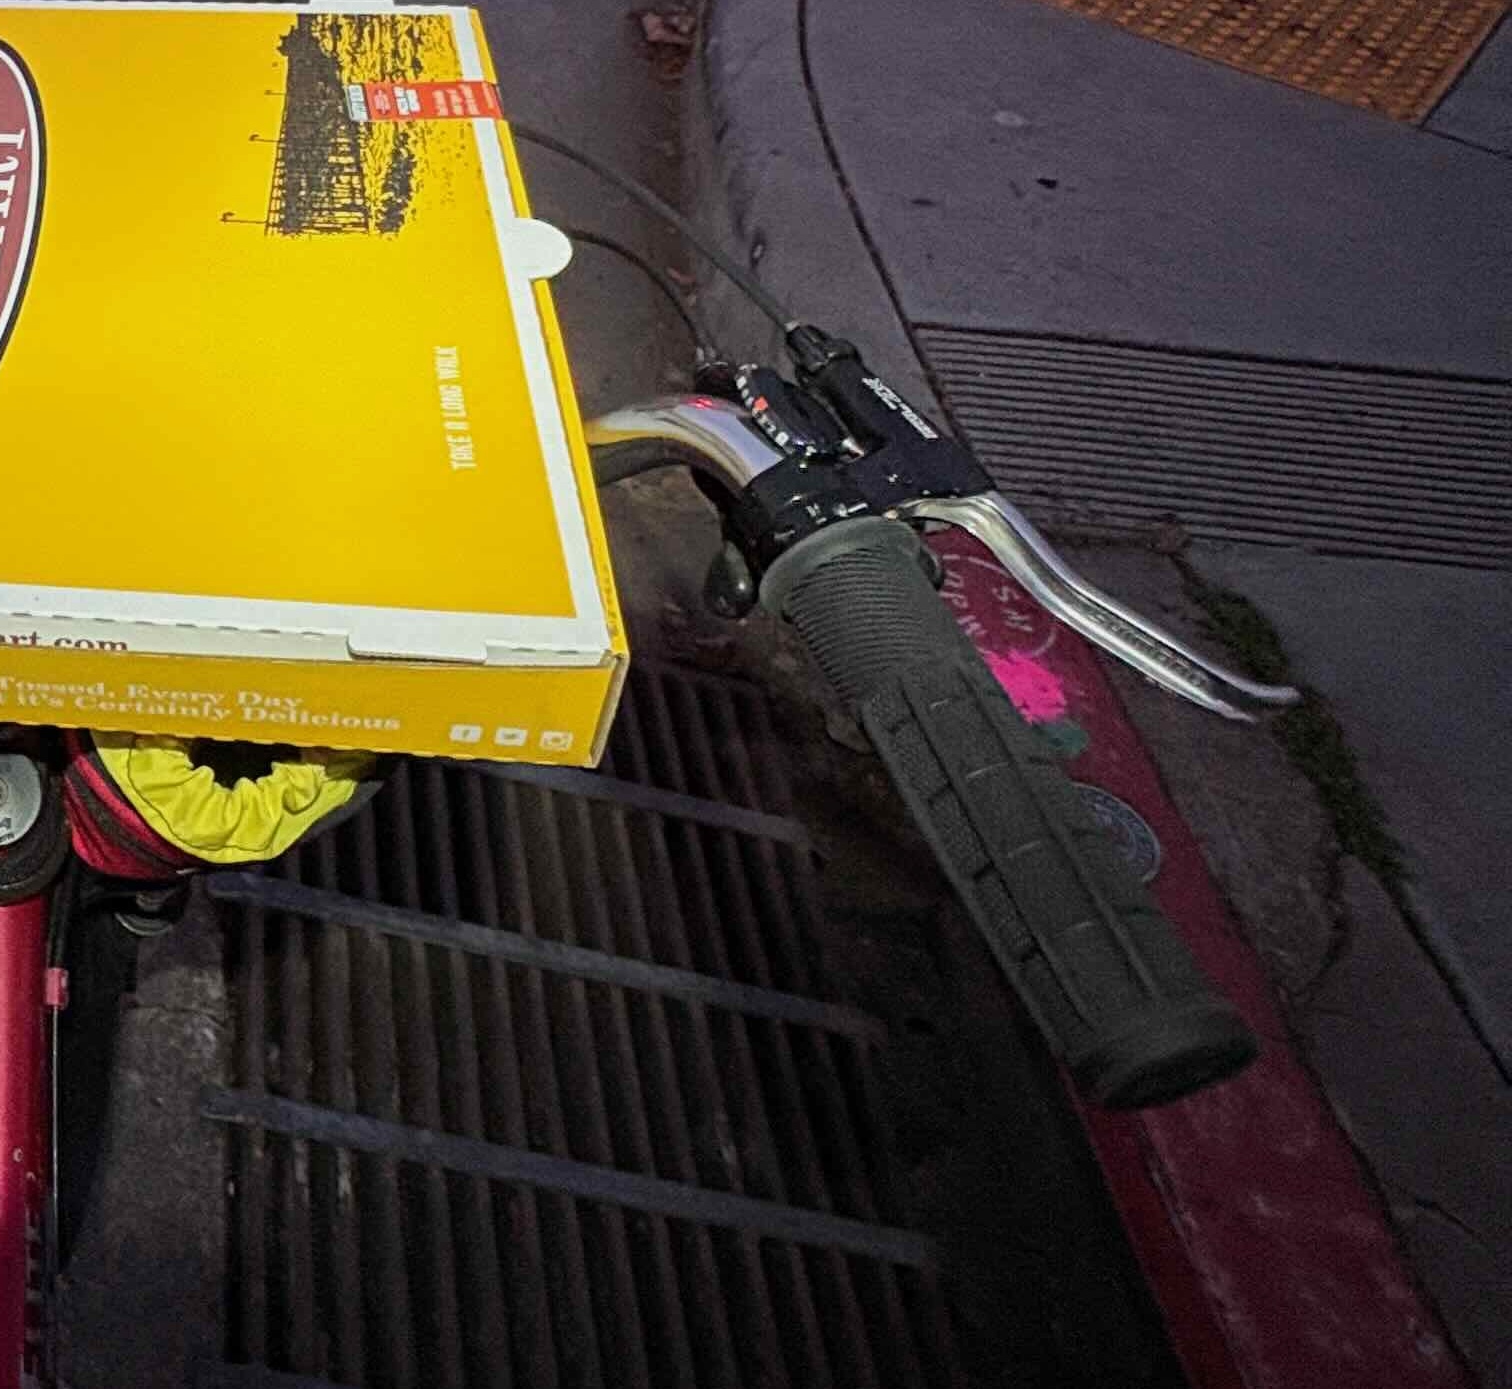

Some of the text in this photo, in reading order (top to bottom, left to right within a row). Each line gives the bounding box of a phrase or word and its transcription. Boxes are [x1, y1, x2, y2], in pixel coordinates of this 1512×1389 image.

[128, 685, 226, 709] Every
[237, 690, 304, 710] Day
[74, 695, 233, 723] Certainly
[241, 705, 402, 732] Delicious
